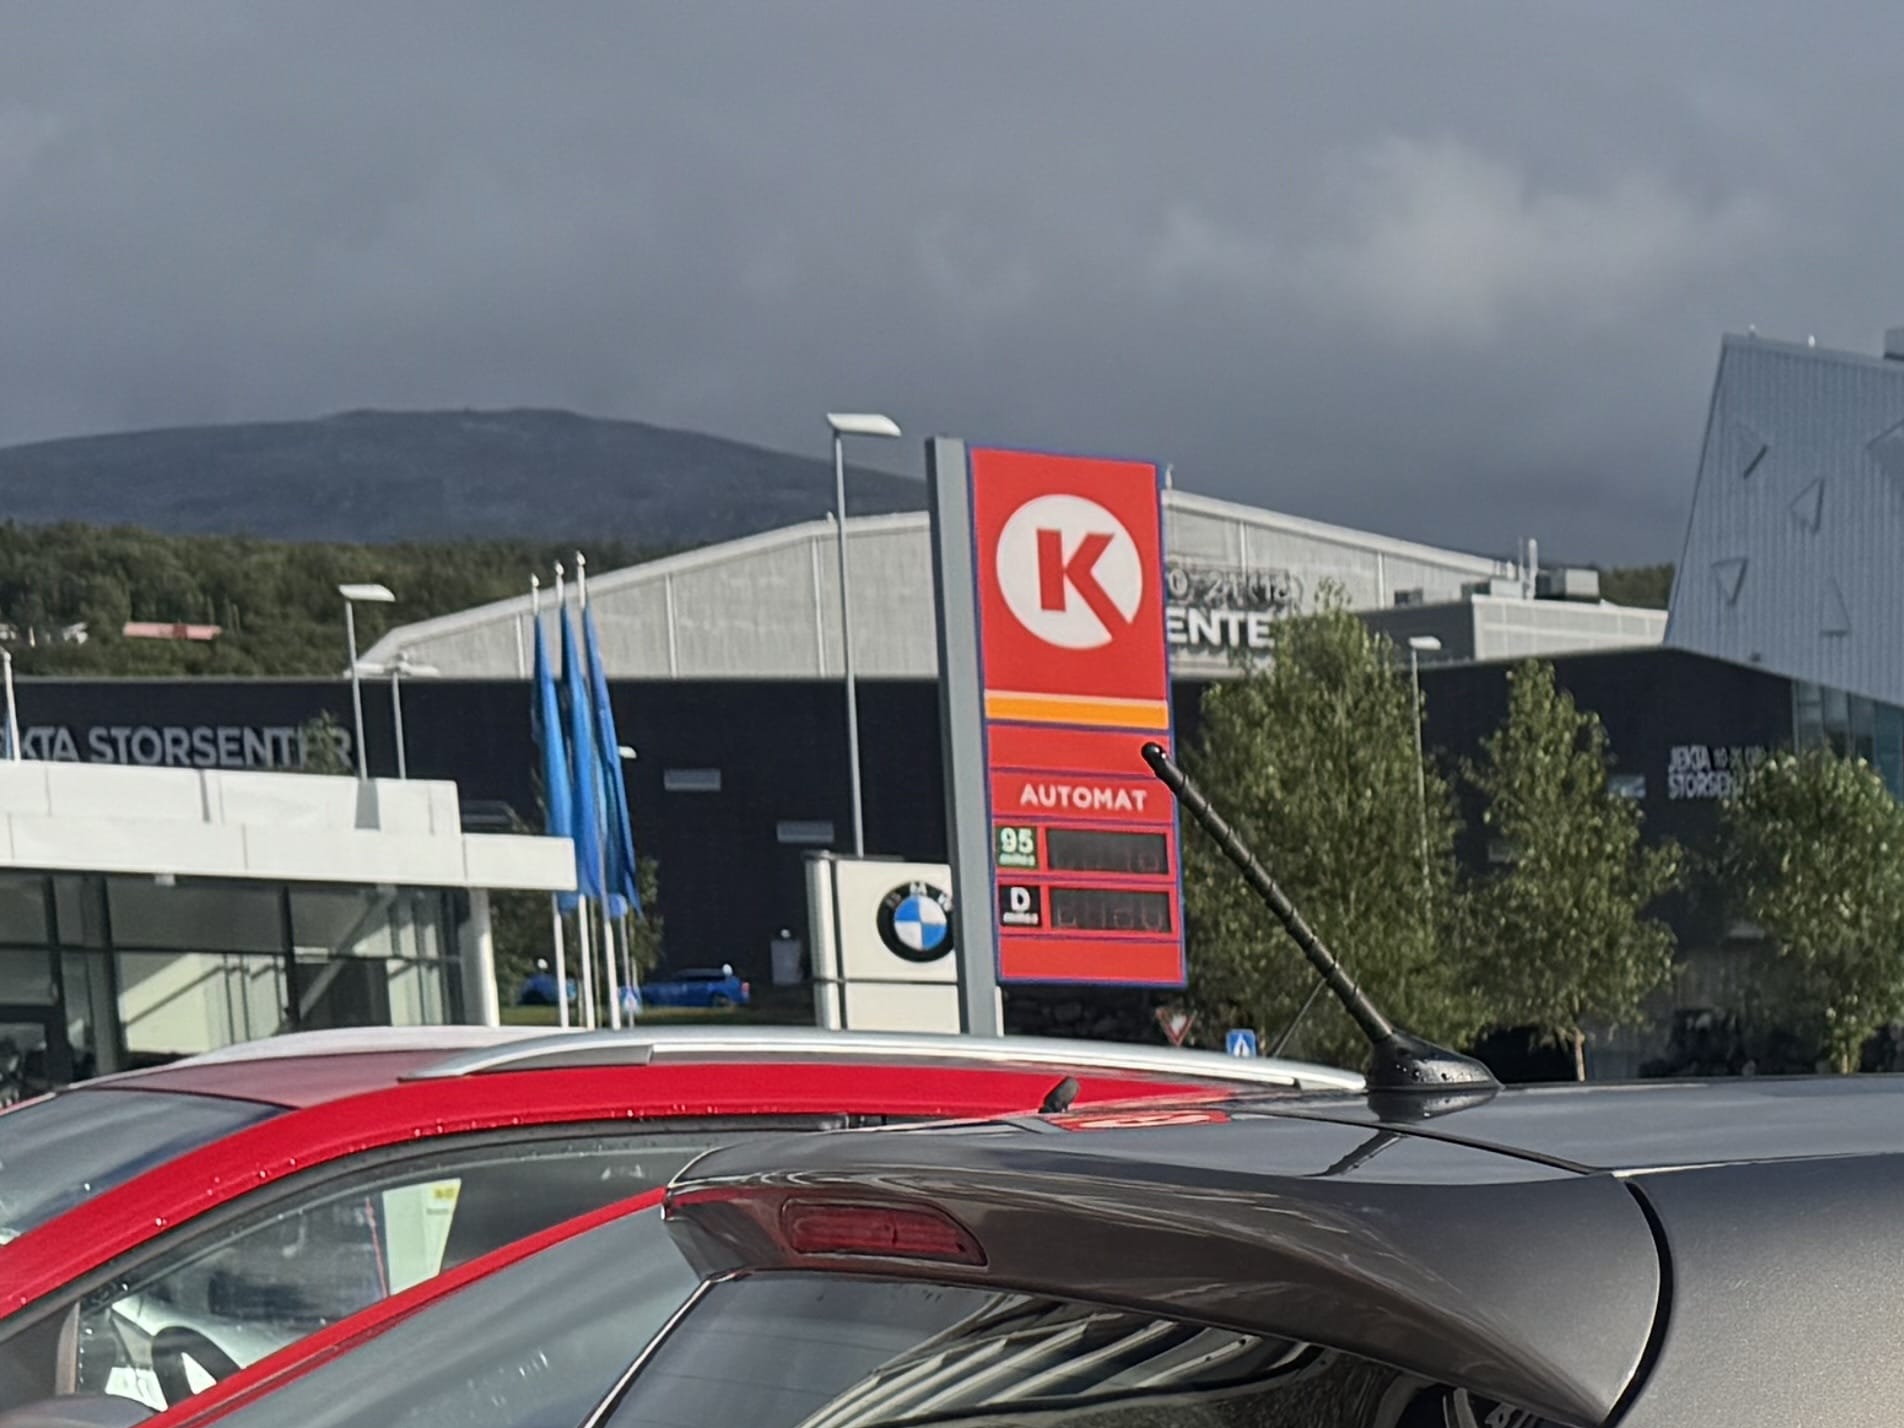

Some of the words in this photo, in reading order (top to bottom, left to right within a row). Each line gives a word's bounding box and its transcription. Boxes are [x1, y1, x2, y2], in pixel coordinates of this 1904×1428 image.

[1020, 783, 1147, 812] AUTOMAT
[1000, 827, 1035, 853] 95
[1010, 886, 1031, 912] D
